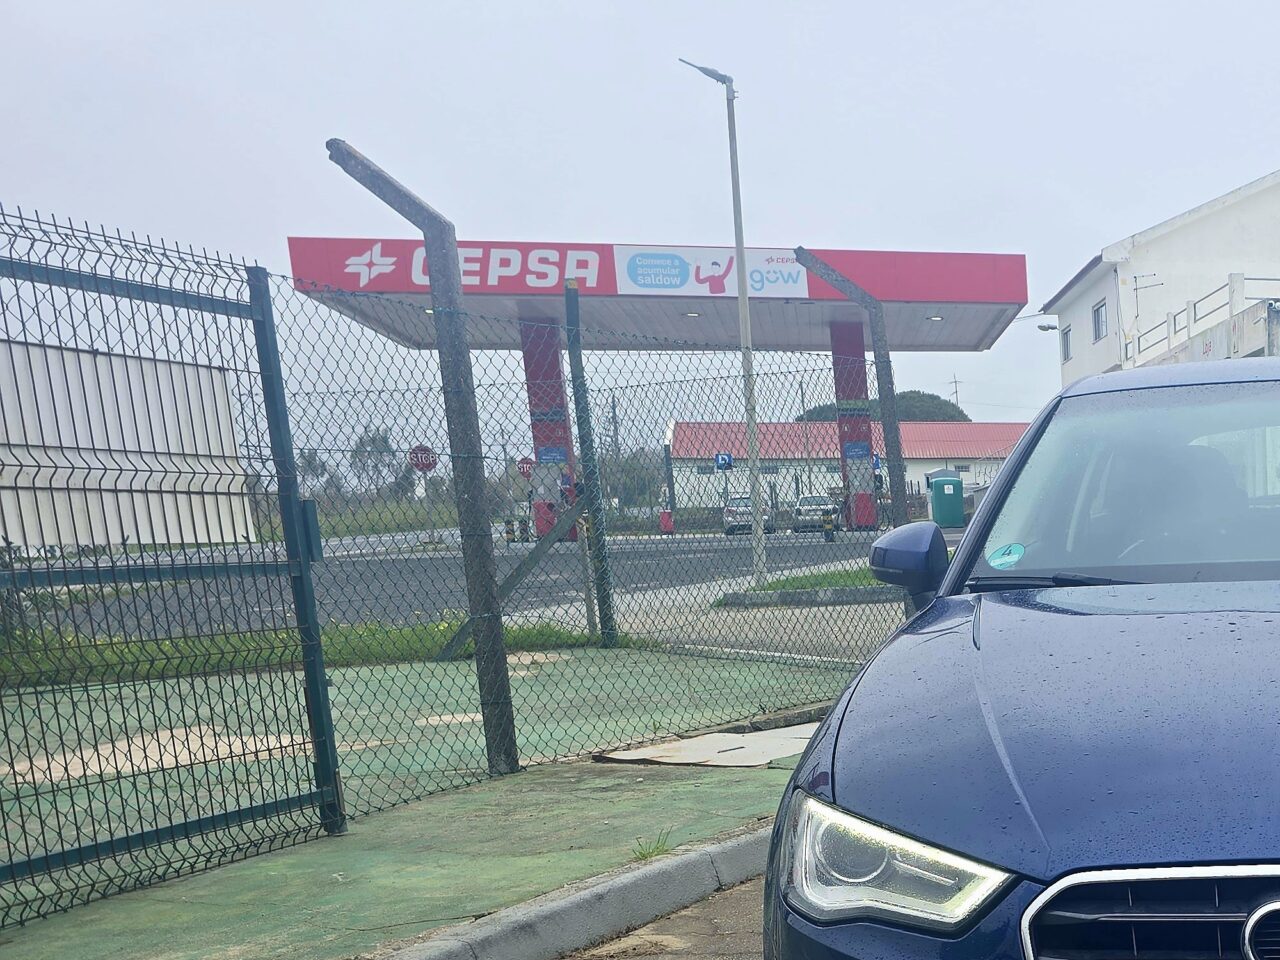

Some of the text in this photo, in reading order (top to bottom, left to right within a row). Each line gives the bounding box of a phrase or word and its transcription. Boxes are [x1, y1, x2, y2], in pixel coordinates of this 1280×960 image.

[636, 257, 672, 265] Comece
[637, 266, 680, 275] acumular
[638, 274, 681, 285] saldow
[410, 454, 436, 464] STOP
[518, 463, 531, 473] STO
[1001, 545, 1012, 556] 4
